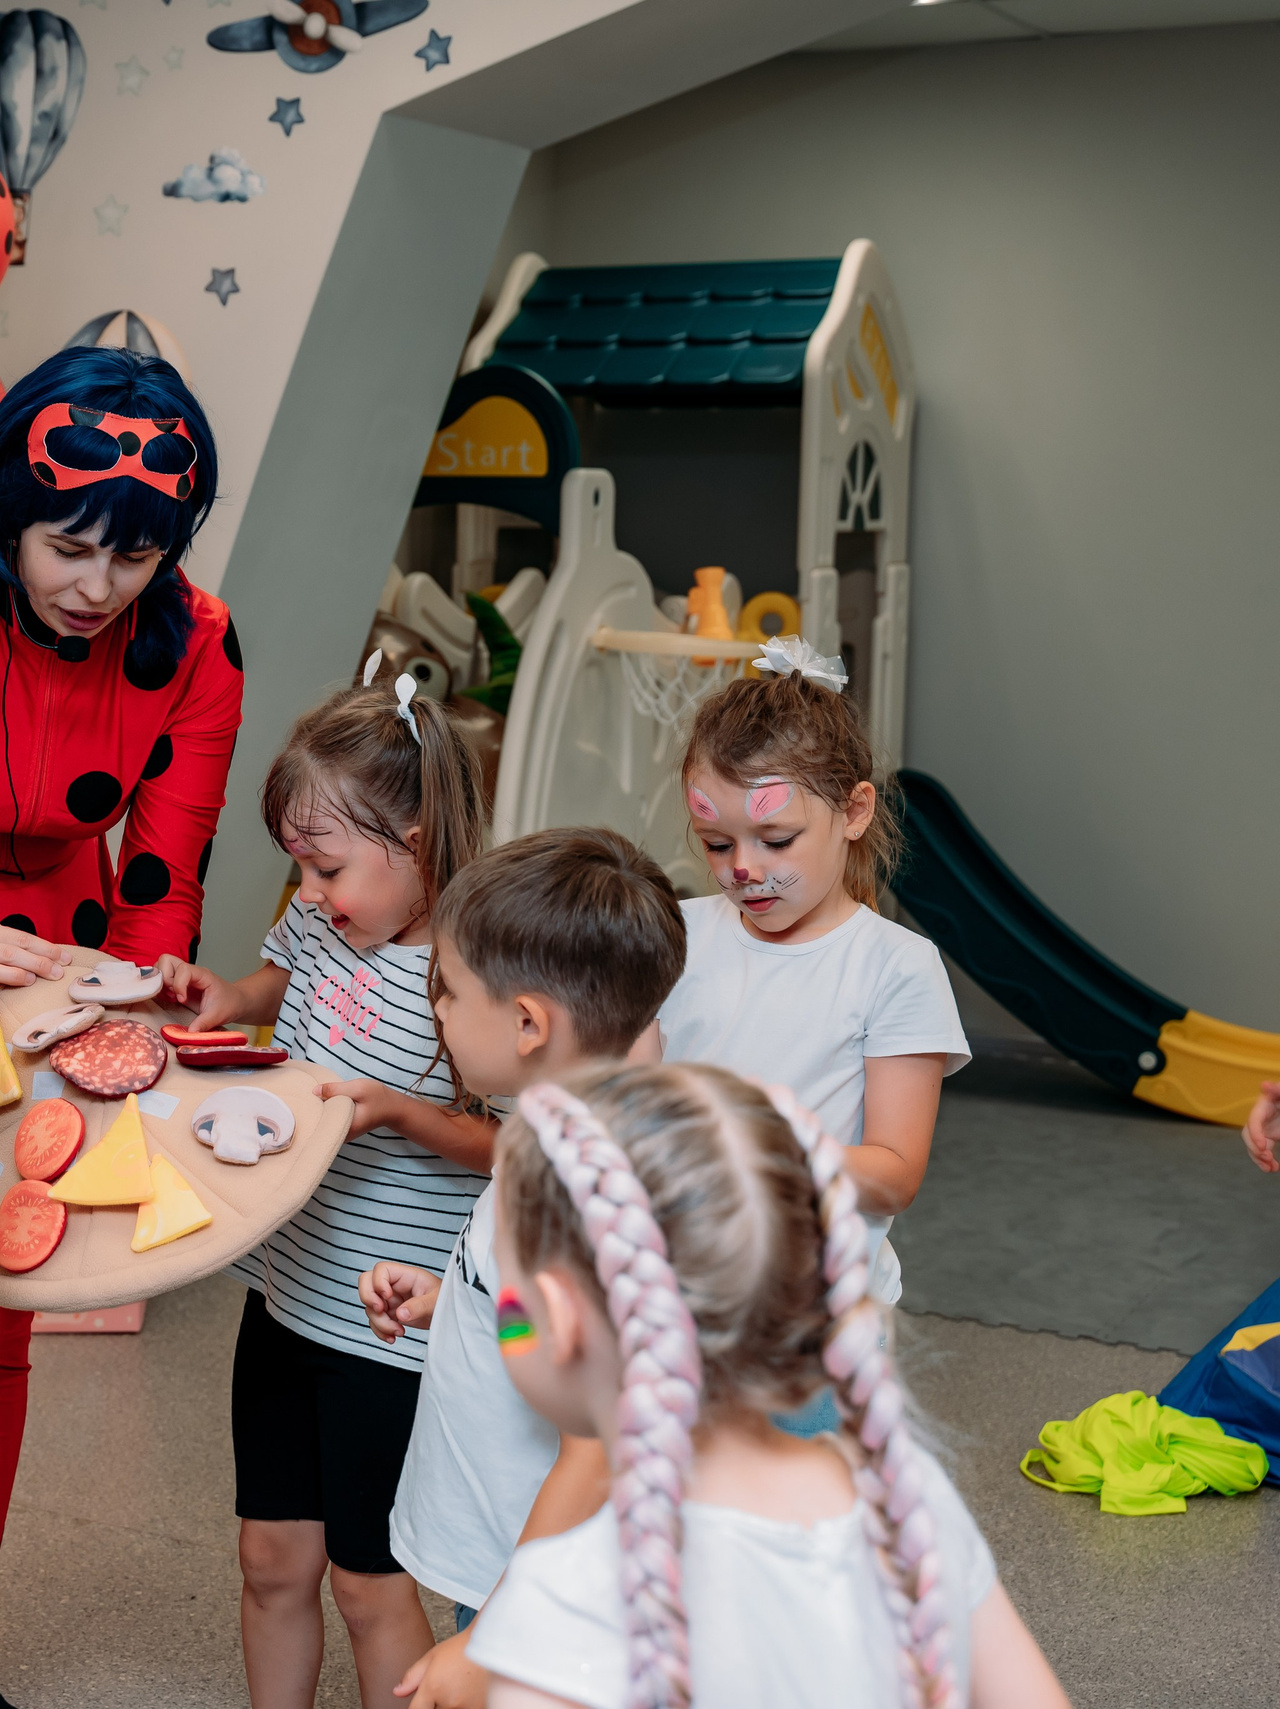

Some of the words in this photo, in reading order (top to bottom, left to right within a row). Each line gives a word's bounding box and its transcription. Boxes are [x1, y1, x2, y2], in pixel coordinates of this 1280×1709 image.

[436, 432, 534, 473] Start
[350, 966, 381, 999] MY
[313, 975, 383, 1042] CHOICE
